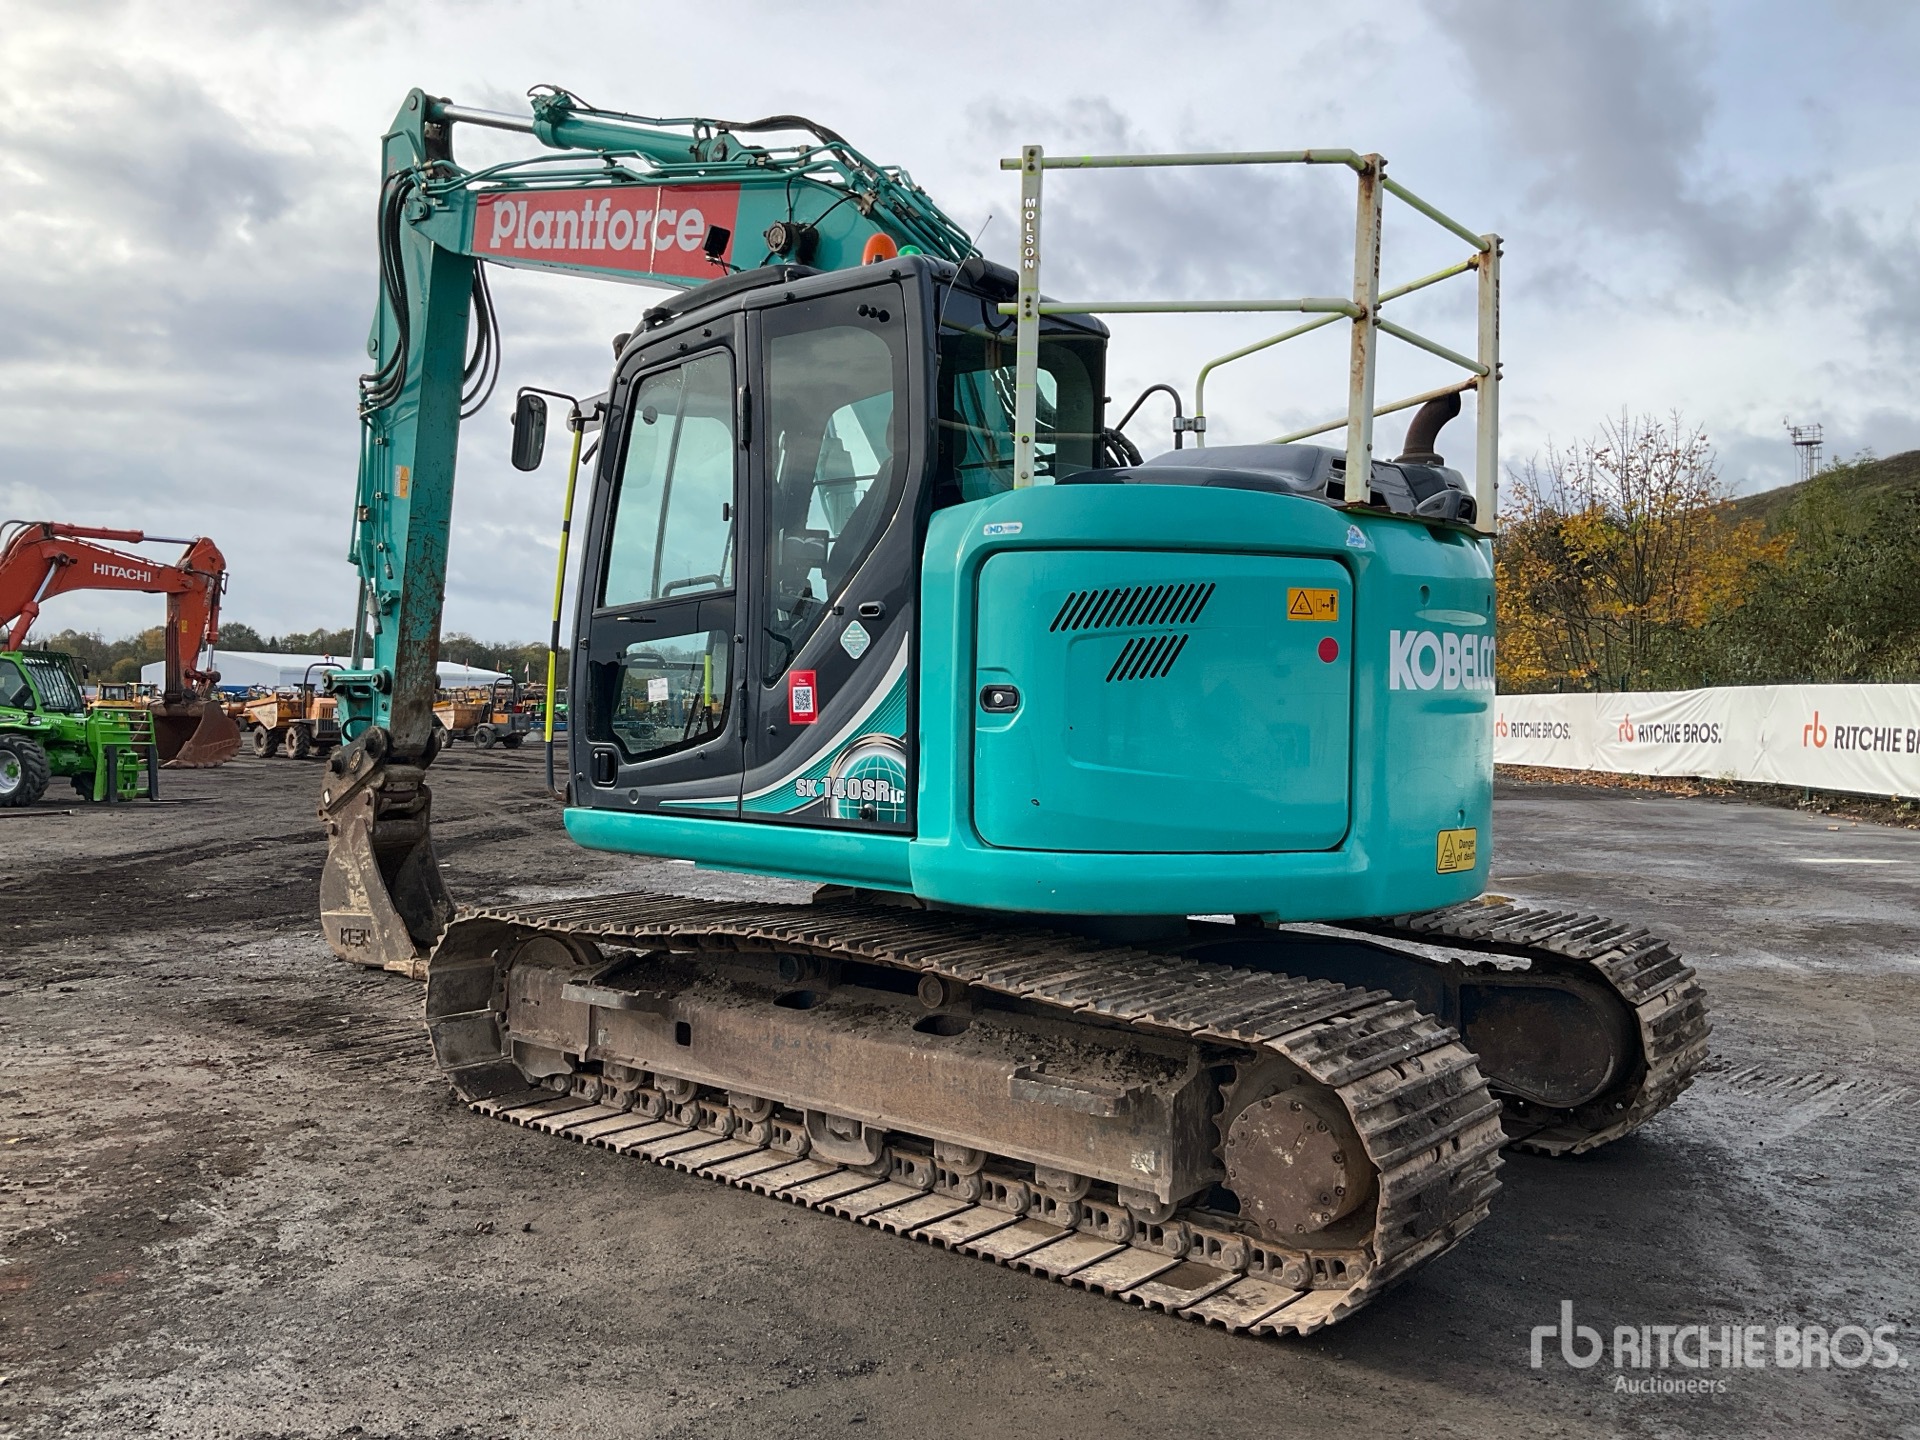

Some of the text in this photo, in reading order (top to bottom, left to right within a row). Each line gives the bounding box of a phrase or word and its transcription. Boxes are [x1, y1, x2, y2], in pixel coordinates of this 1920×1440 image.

[490, 198, 705, 252] Plantforce
[1024, 198, 1036, 269] MOLSON
[93, 562, 152, 583] HITACHI
[1389, 629, 1496, 691] KOBELCO
[1510, 722, 1541, 739] RITCHIE
[1542, 722, 1571, 740] BROS.
[1638, 723, 1681, 743] RITCHIE
[1683, 722, 1722, 744] BROS.
[1834, 725, 1902, 753] RITCHIE
[795, 778, 818, 797] SK
[1459, 839, 1475, 850] Danger
[1457, 852, 1463, 862] of
